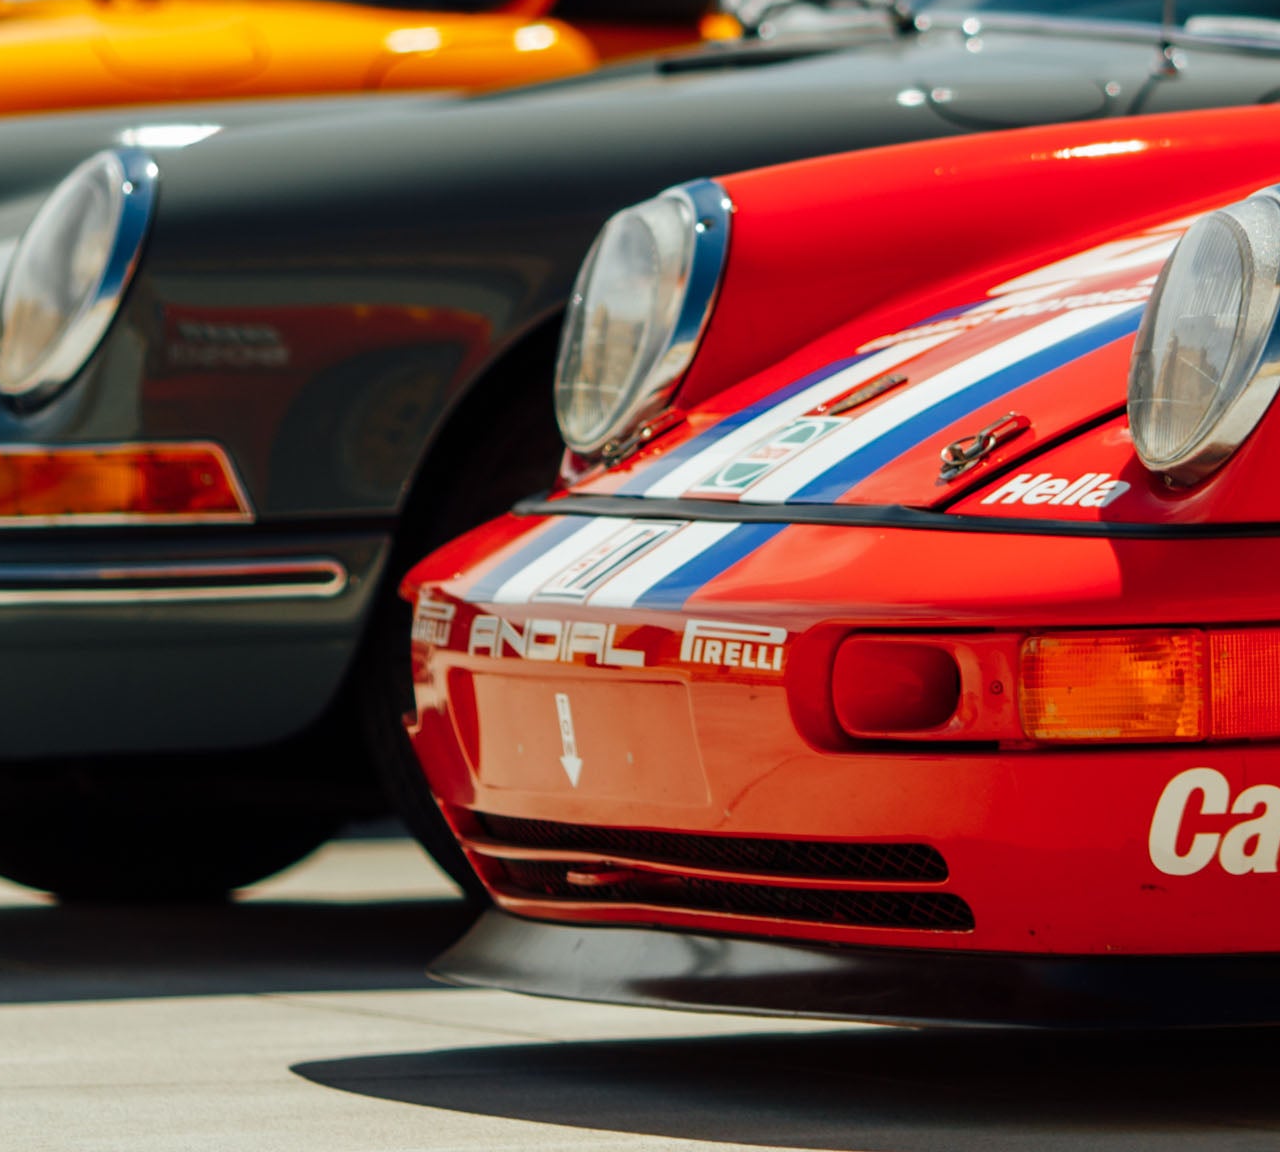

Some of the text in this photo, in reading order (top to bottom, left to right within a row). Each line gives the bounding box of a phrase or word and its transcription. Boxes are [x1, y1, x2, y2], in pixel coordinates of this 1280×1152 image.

[980, 472, 1130, 508] Hella
[467, 614, 646, 667] ANDIAL
[679, 618, 788, 672] PIRELLI
